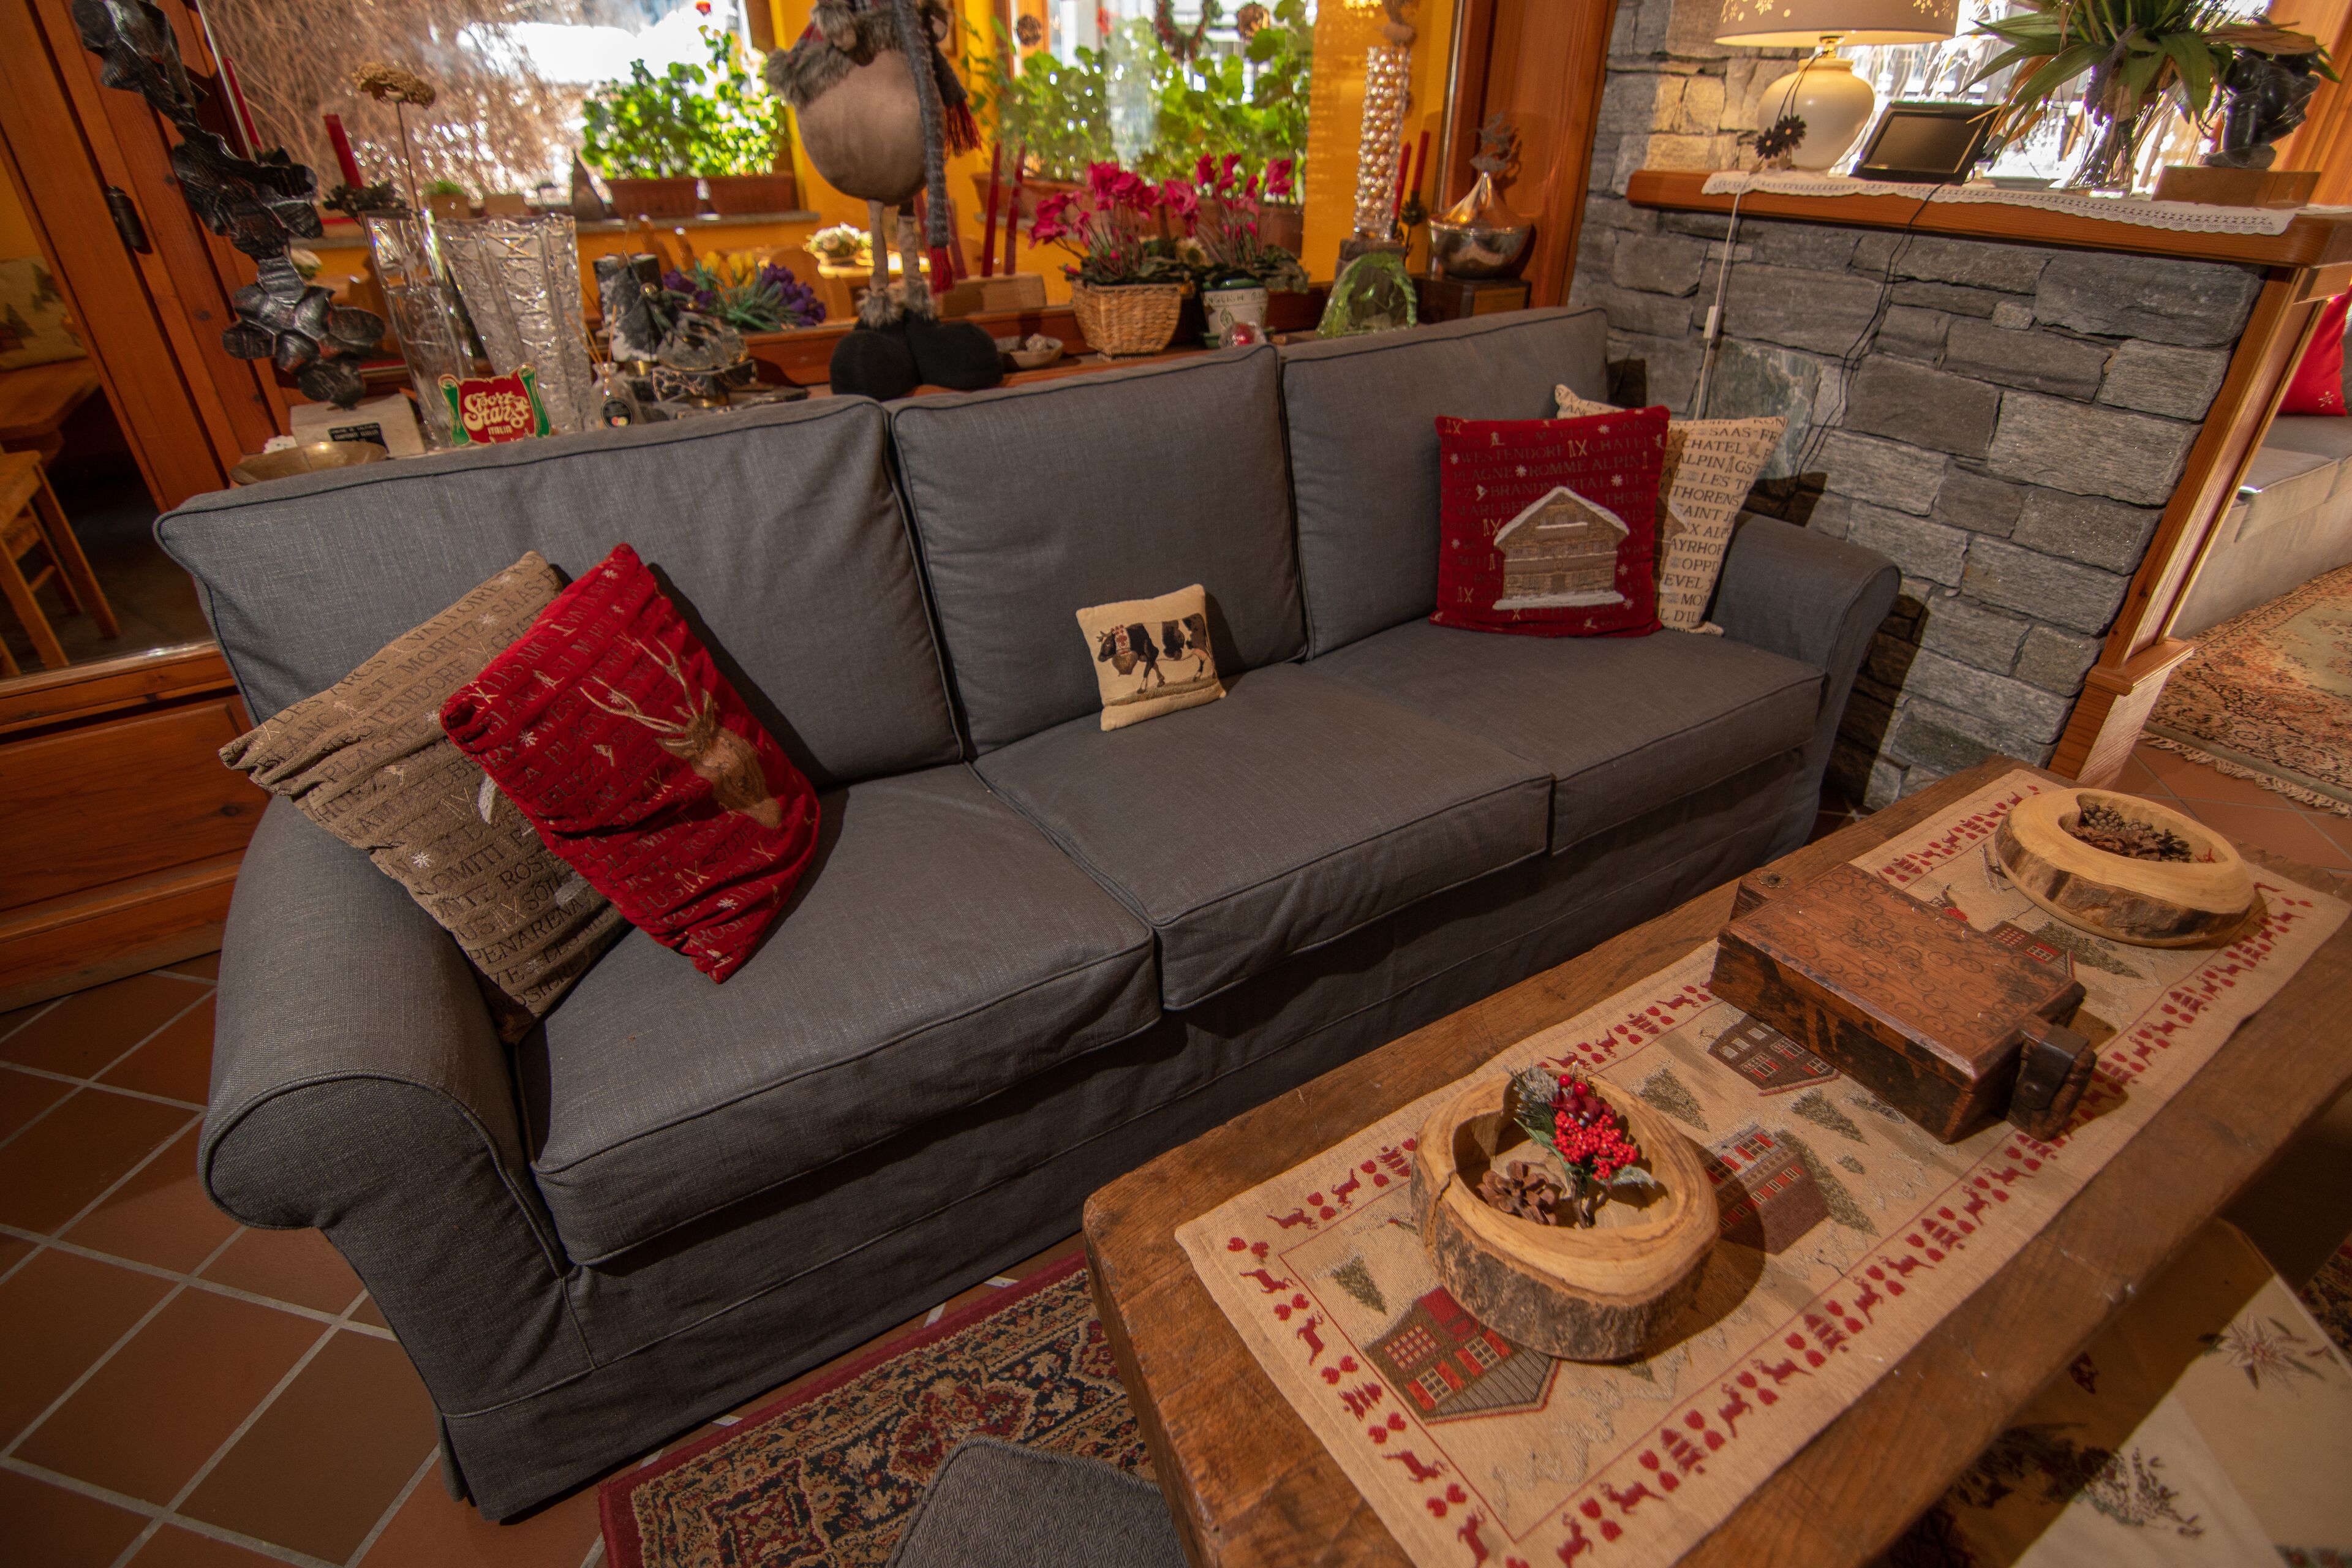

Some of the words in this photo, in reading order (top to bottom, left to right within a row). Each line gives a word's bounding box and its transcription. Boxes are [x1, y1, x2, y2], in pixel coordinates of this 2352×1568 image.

[464, 390, 516, 412] Sport
[464, 396, 530, 431] Stars
[1681, 439, 1745, 454] CHATEL
[1529, 459, 1588, 478] ROMME
[1675, 453, 1725, 470] ALPIN
[1700, 472, 1731, 488] LES
[1672, 484, 1740, 507] THORENS
[1671, 538, 1726, 556] AYRHOF
[396, 619, 486, 676] MORITZ
